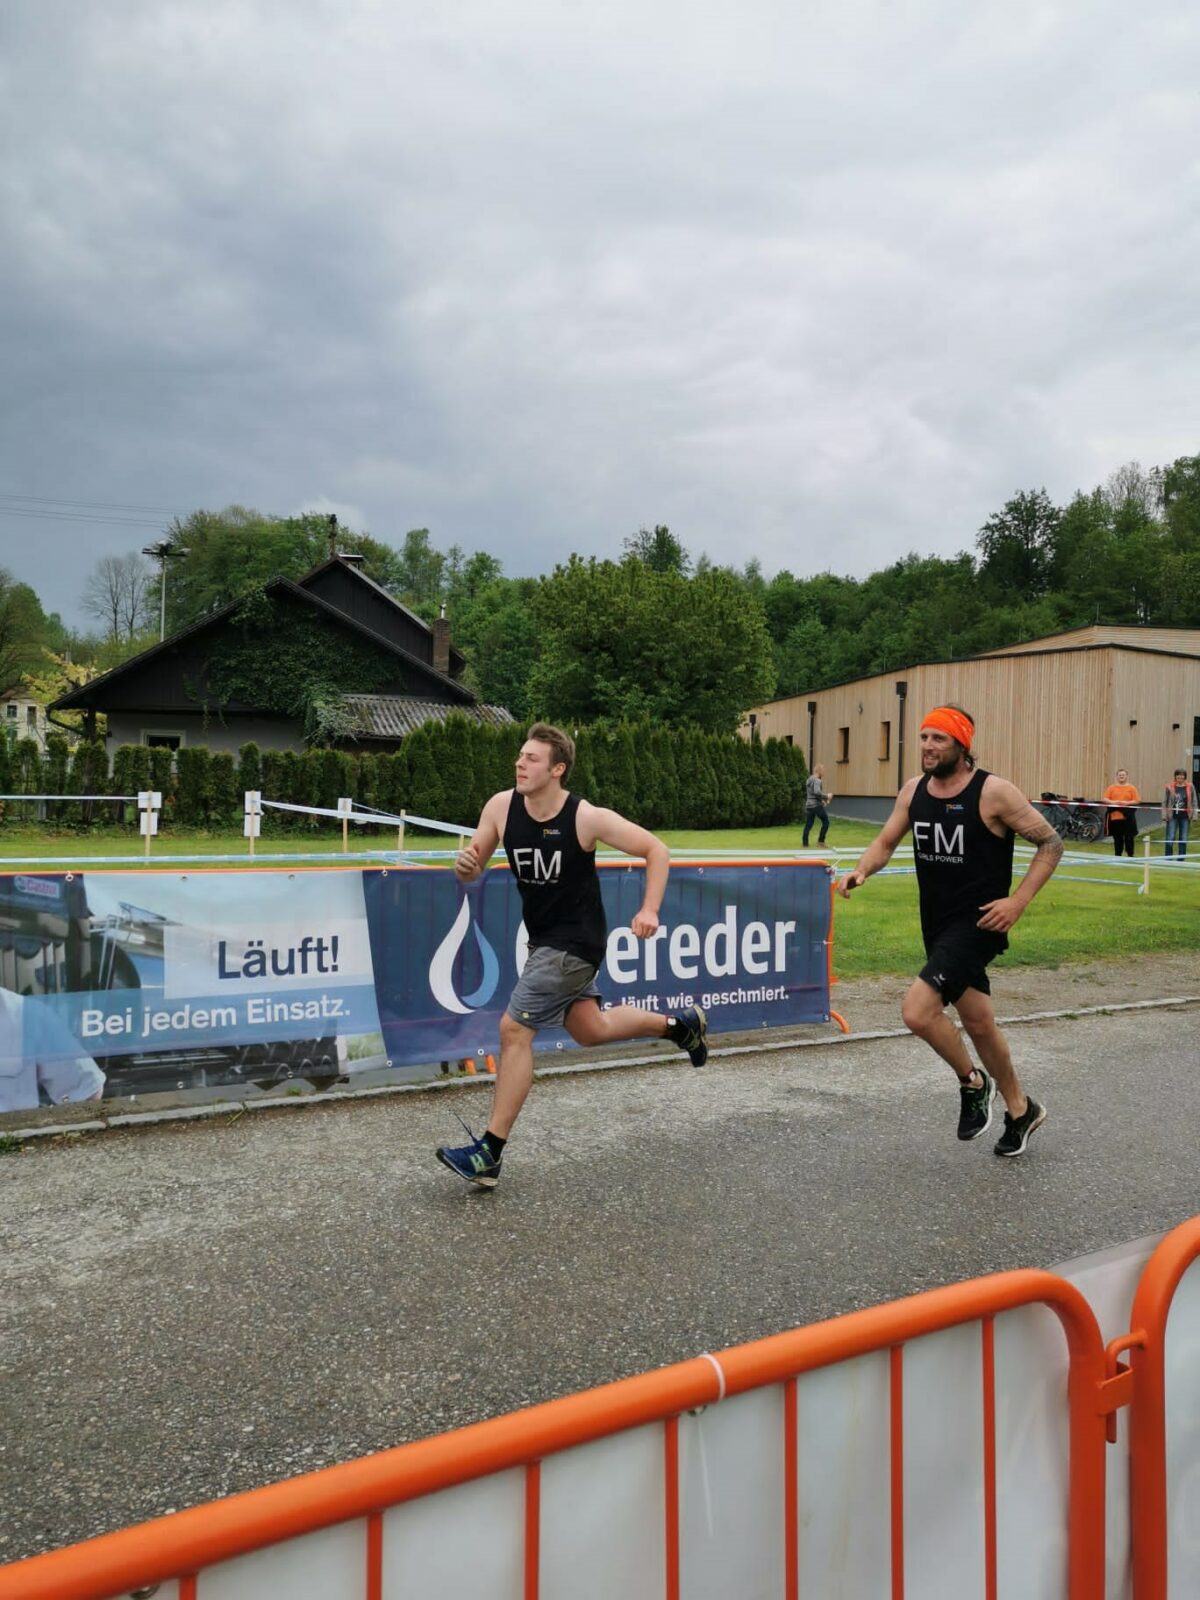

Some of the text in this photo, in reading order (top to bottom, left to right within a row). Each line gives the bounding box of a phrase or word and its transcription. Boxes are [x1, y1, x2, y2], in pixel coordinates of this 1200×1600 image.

[914, 821, 965, 855] FM
[513, 847, 562, 881] FM
[935, 855, 963, 863] POWER
[218, 935, 340, 980] Läuft!
[667, 992, 695, 1009] wie
[702, 985, 789, 1010] geschmiert.
[81, 994, 351, 1038] Bei jedem Einsatz.
